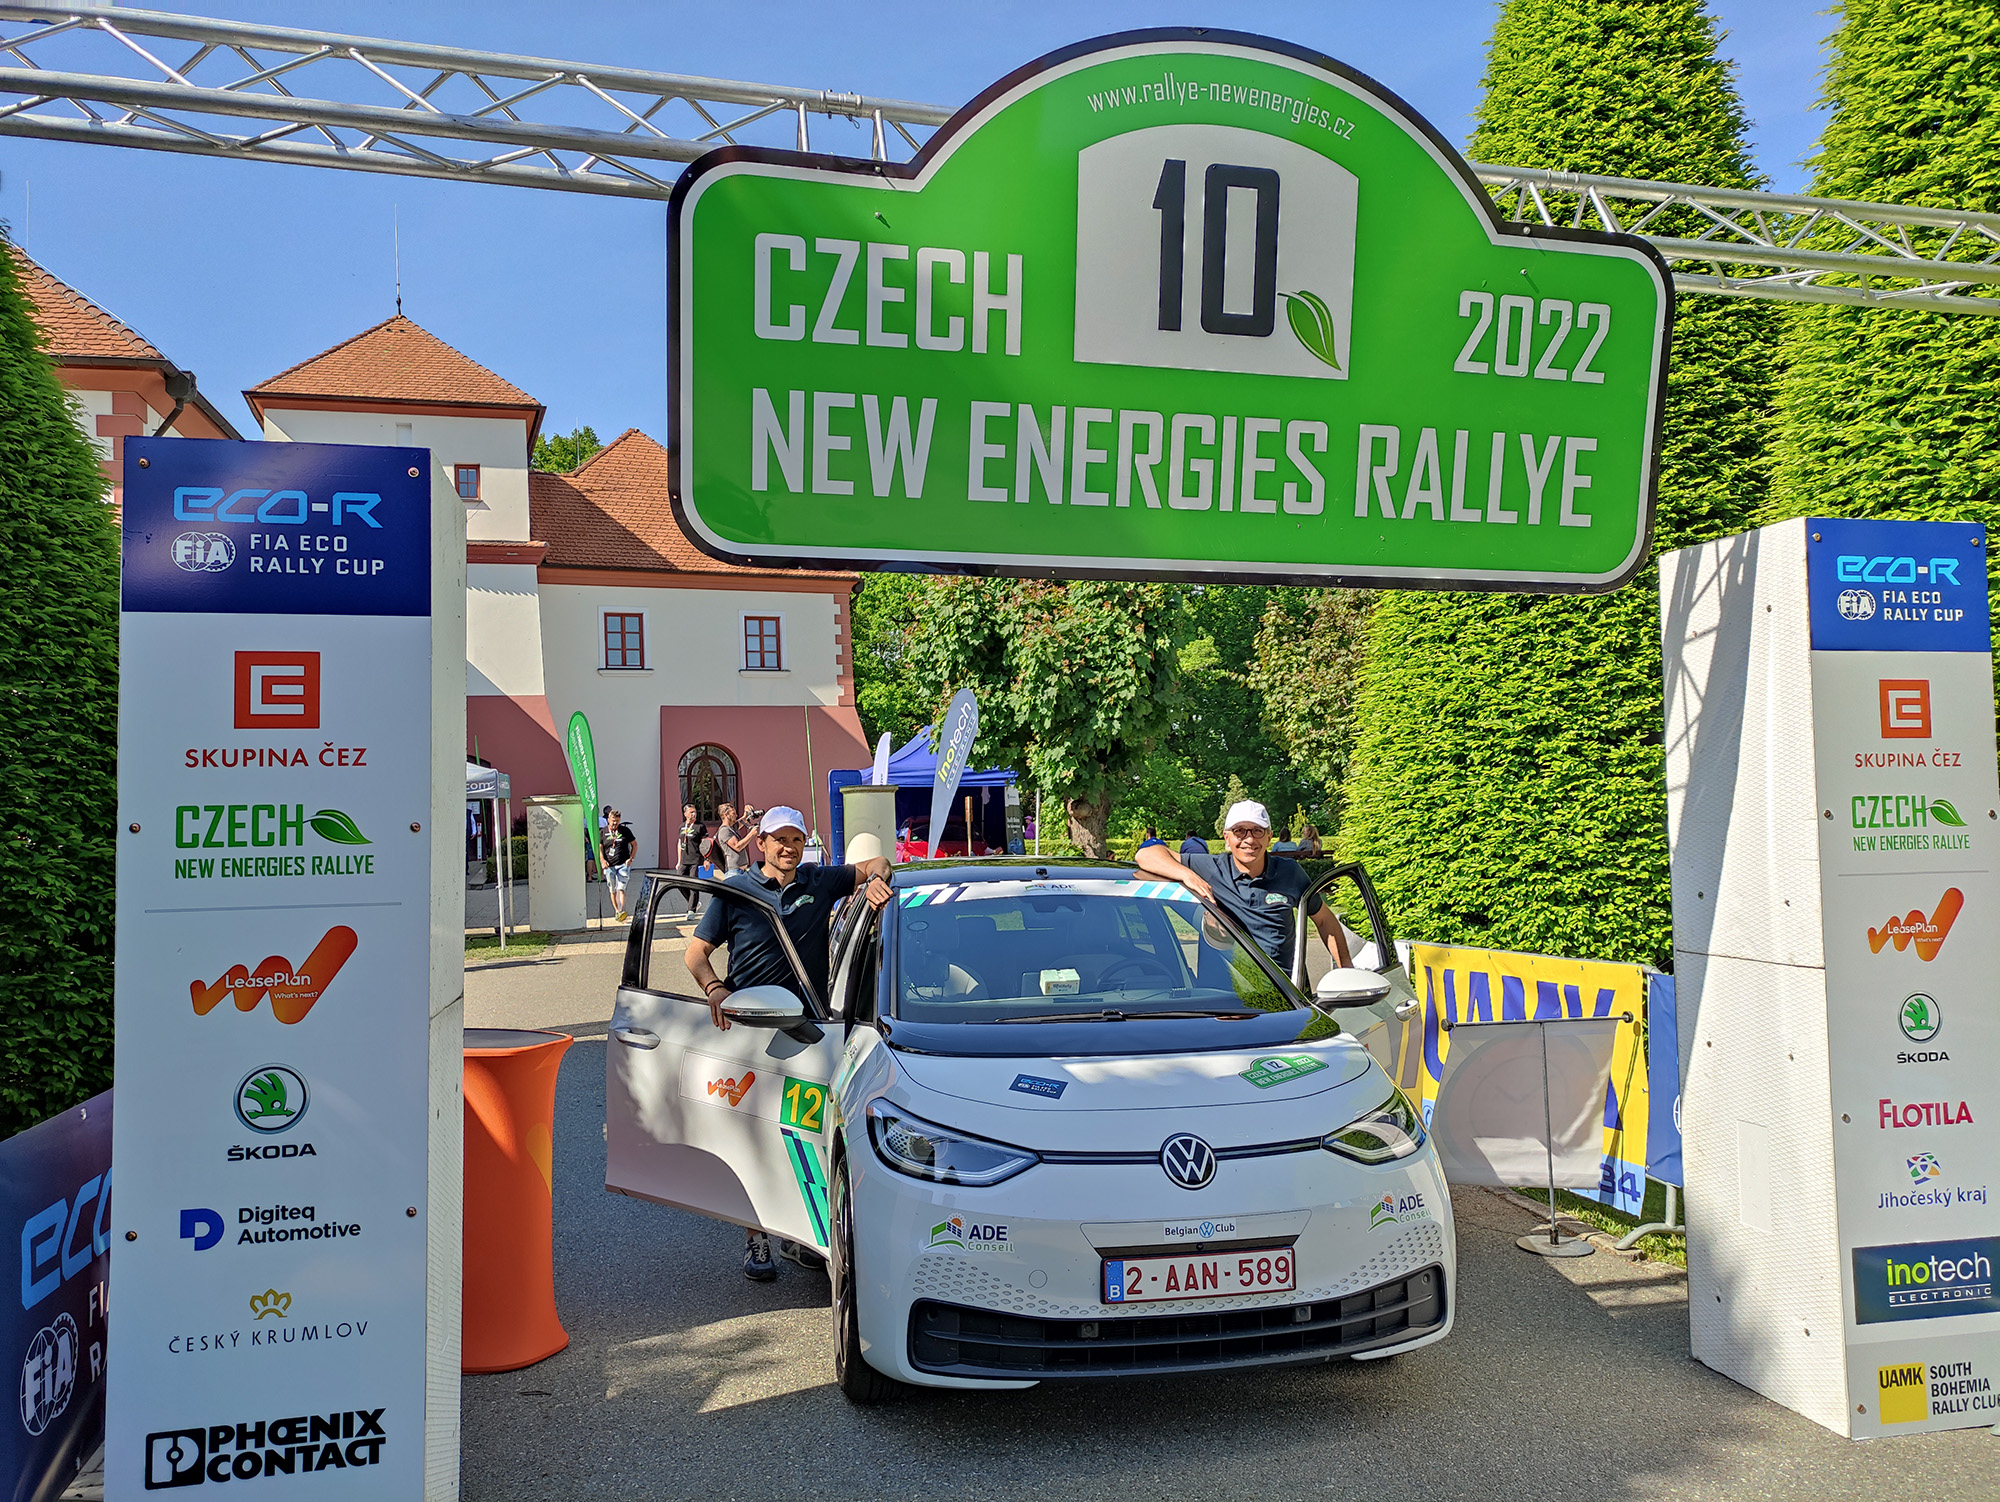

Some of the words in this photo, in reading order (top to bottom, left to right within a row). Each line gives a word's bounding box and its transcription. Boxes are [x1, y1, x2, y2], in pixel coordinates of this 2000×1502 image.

[1087, 72, 1356, 141] www.rallye-newenergies.cz
[1152, 158, 1281, 338] 10
[753, 232, 1024, 356] CZECH
[1453, 289, 1612, 384] 2022
[751, 387, 938, 499] NEW
[967, 400, 1329, 517] ENERGIES
[1354, 423, 1598, 528] RALLYE
[250, 533, 289, 550] FIA
[300, 535, 348, 552] ECO
[250, 556, 325, 574] RALLY
[336, 558, 385, 576] CUP
[1883, 591, 1907, 604] FIA
[1912, 591, 1941, 604] ECO
[1884, 607, 1928, 621] RALLY
[1934, 608, 1964, 622] CUP
[937, 701, 972, 782] inotech
[184, 747, 309, 768] SKUPINA
[318, 742, 367, 767] ČEZ
[1854, 752, 1927, 768] SKUPINA
[1932, 748, 1962, 767] ČEZ
[1851, 795, 1927, 829] CZECH
[175, 803, 304, 849] CZECH
[1853, 836, 1877, 851] NEW
[1880, 835, 1930, 850] ENERGIES
[1933, 834, 1970, 850] RALLYE
[174, 858, 214, 879] NEW
[221, 856, 305, 878] ENERGIES
[311, 855, 375, 875] RALLYE
[1887, 922, 1938, 934] LeasePlan
[225, 972, 311, 989] LeasePlan
[274, 991, 299, 999] What's
[300, 991, 318, 999] next?
[1897, 1051, 1950, 1064] ŠKODA
[786, 1083, 822, 1129] 12
[1878, 1098, 1974, 1129] FLOTILA
[227, 1142, 317, 1162] ŠKODA
[1398, 1193, 1425, 1213] ADE
[1878, 1187, 1952, 1209] Jihočeský
[1957, 1185, 1987, 1204] kraj
[238, 1204, 316, 1226] Digiteq
[1399, 1207, 1432, 1224] Conseil
[237, 1221, 361, 1247] Automotive
[968, 1224, 1008, 1241] ADE
[1165, 1224, 1199, 1237] Belgian
[1215, 1222, 1236, 1233] Club
[968, 1241, 1014, 1252] Conseil
[1887, 1252, 1991, 1286] inotech
[1110, 1284, 1121, 1298] B
[1889, 1287, 1992, 1303] ELECTRONIC
[169, 1329, 241, 1354] ČESKÝ
[252, 1321, 369, 1346] KRUMLOV
[1879, 1366, 1924, 1389] UAMK
[1930, 1361, 1972, 1379] SOUTH
[1931, 1378, 1991, 1398] BOHEMIA
[1932, 1398, 1970, 1415] RALLY
[206, 1437, 387, 1483] CONTACT
